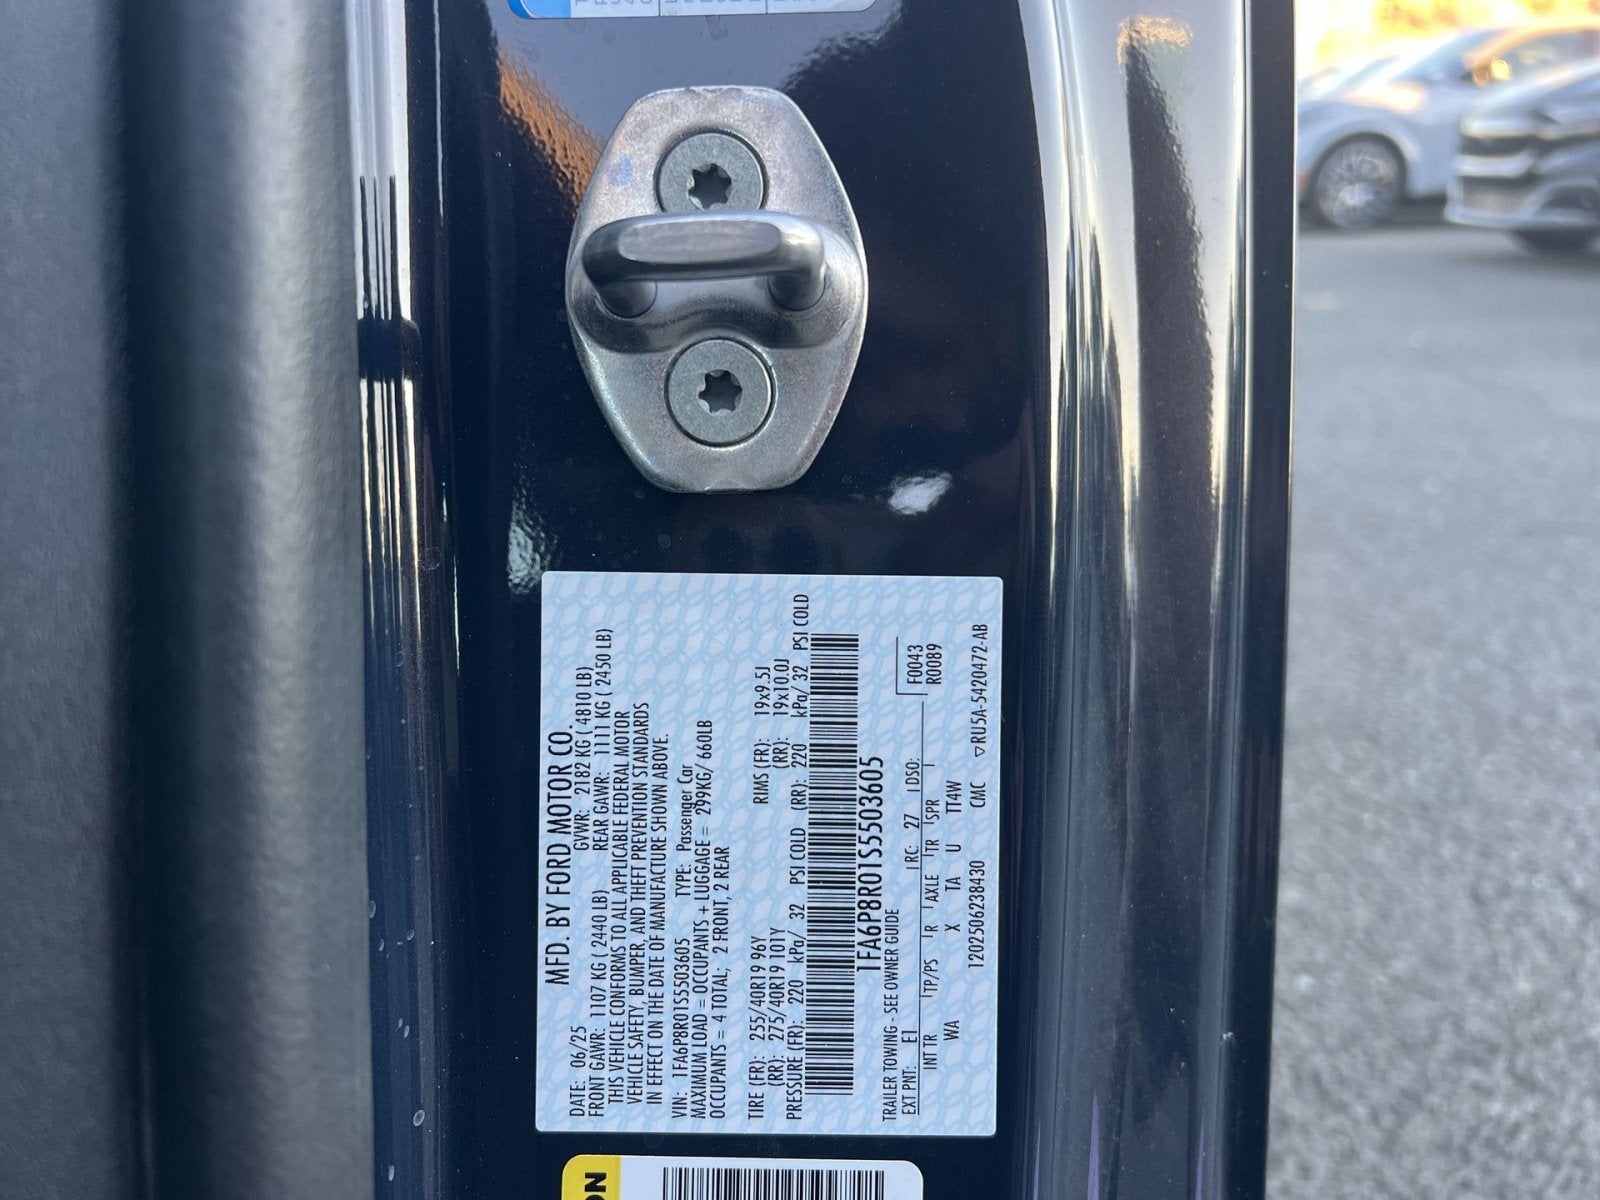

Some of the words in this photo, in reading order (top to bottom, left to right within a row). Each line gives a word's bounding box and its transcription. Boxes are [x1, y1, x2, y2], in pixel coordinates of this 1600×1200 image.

[793, 594, 809, 627] COLD
[596, 628, 613, 649] LB)
[792, 632, 809, 650] PSI
[575, 666, 594, 687] LB)
[595, 653, 611, 686] 2450
[792, 665, 808, 681] 32
[907, 645, 923, 684] F0043
[925, 643, 942, 684] R0089
[754, 666, 771, 716] 19x9.5J
[773, 658, 790, 716] 19x10.0J
[791, 687, 810, 718] kPa/
[575, 692, 592, 725] 4810
[595, 701, 611, 718] KG
[548, 725, 573, 756] CO.
[575, 740, 591, 757] KG
[594, 724, 610, 755] 1111
[614, 711, 630, 757] MOTOR
[633, 702, 649, 778] STANDARDS
[696, 720, 712, 759] 660LB
[652, 734, 669, 779] ABOVE.
[753, 739, 772, 769] (FR):
[772, 737, 790, 769] (RR):
[791, 743, 807, 768] 220
[574, 762, 591, 795] 2182
[613, 761, 629, 814] FEDERAL
[677, 764, 693, 784] Car
[905, 758, 920, 785] DSO:
[547, 765, 572, 835] MOTOR
[593, 772, 610, 814] GAWR:
[695, 764, 713, 815] 299KG/
[753, 773, 769, 804] RIMS
[790, 779, 808, 811] (RR):
[945, 780, 962, 814] TT4W
[970, 782, 986, 808] CMC
[631, 782, 648, 860] PREVENTION
[651, 784, 667, 831] SHOWN
[676, 790, 698, 851] Passenger
[904, 814, 920, 829] 27
[925, 799, 940, 820] SPR
[573, 810, 590, 850] GVWR:
[593, 819, 609, 850] REAR
[790, 827, 806, 860] COLD
[925, 839, 940, 852] TR
[611, 820, 629, 893] APPLICABLE
[713, 847, 730, 879] REAR
[856, 756, 883, 972] 1FA6P8R01S5503605
[904, 845, 919, 862] RC:
[945, 844, 961, 852] U
[546, 843, 571, 895] FORD
[631, 865, 647, 901] THEFT
[649, 837, 667, 930] MANUFACTURE
[675, 864, 692, 898] TYPE:
[694, 840, 710, 900] LUGGAGE
[790, 866, 806, 884] PSI
[945, 877, 961, 891] TA
[592, 889, 609, 910] LB)
[924, 874, 939, 902] AXLE
[546, 903, 571, 927] BY
[611, 899, 627, 920] ALL
[630, 907, 646, 934] AND
[712, 897, 732, 941] FRONT,
[789, 903, 805, 920] 32
[968, 860, 985, 969] 1202506238430
[591, 915, 607, 948] 2440
[611, 925, 626, 941] TO
[884, 909, 899, 944] GUIDE
[944, 924, 961, 932] X
[649, 935, 665, 951] OF
[692, 920, 709, 994] OCCUPANTS
[712, 946, 728, 954] 2
[750, 935, 766, 960] 96Y
[769, 927, 785, 959] 101Y
[787, 931, 806, 963] kPa/
[545, 936, 570, 985] MFD.
[591, 963, 607, 980] KG
[629, 939, 648, 996] BUMPER,
[648, 956, 664, 987] DATE
[884, 948, 899, 990] OWNER
[923, 959, 940, 992] TP/PS
[609, 946, 626, 1016] CONFORMS
[711, 968, 730, 1010] TOTAL;
[788, 979, 804, 1004] 220
[590, 986, 606, 1017] 1107
[648, 992, 664, 1016] THE
[672, 938, 690, 1078] 1FA6P8R01S5503605
[749, 965, 767, 1041] 255/40R19
[768, 965, 786, 1041] 275/40R19
[884, 994, 898, 1014] SEE
[628, 1001, 647, 1049] SAFETY,
[647, 1020, 663, 1039] ON
[692, 1014, 708, 1047] LOAD
[711, 1015, 726, 1023] 4
[787, 1020, 804, 1050] (FR):
[943, 1020, 960, 1040] WA
[569, 1026, 588, 1068] 06/25
[589, 1028, 606, 1071] GAWR:
[609, 1021, 625, 1071] VEHICLE
[883, 1026, 898, 1072] TOWING
[901, 1030, 918, 1043] E1
[923, 1034, 938, 1047] TR
[647, 1043, 663, 1086] EFFECT
[749, 1056, 766, 1086] (FR):
[767, 1055, 785, 1087] (RR):
[923, 1051, 937, 1070] INT
[608, 1077, 624, 1104] THIS
[627, 1054, 643, 1104] VEHICLE
[691, 1052, 707, 1119] MAXIMUM
[710, 1044, 726, 1119] OCCUPANTS
[786, 1057, 804, 1120] PRESSURE
[902, 1066, 917, 1090] PNT:
[569, 1081, 586, 1117] DATE:
[589, 1076, 605, 1117] FRONT
[646, 1091, 662, 1105] IN
[671, 1092, 688, 1118] VIN:
[748, 1092, 764, 1120] TIRE
[882, 1076, 898, 1121] TRAILER
[901, 1095, 916, 1115] EXT
